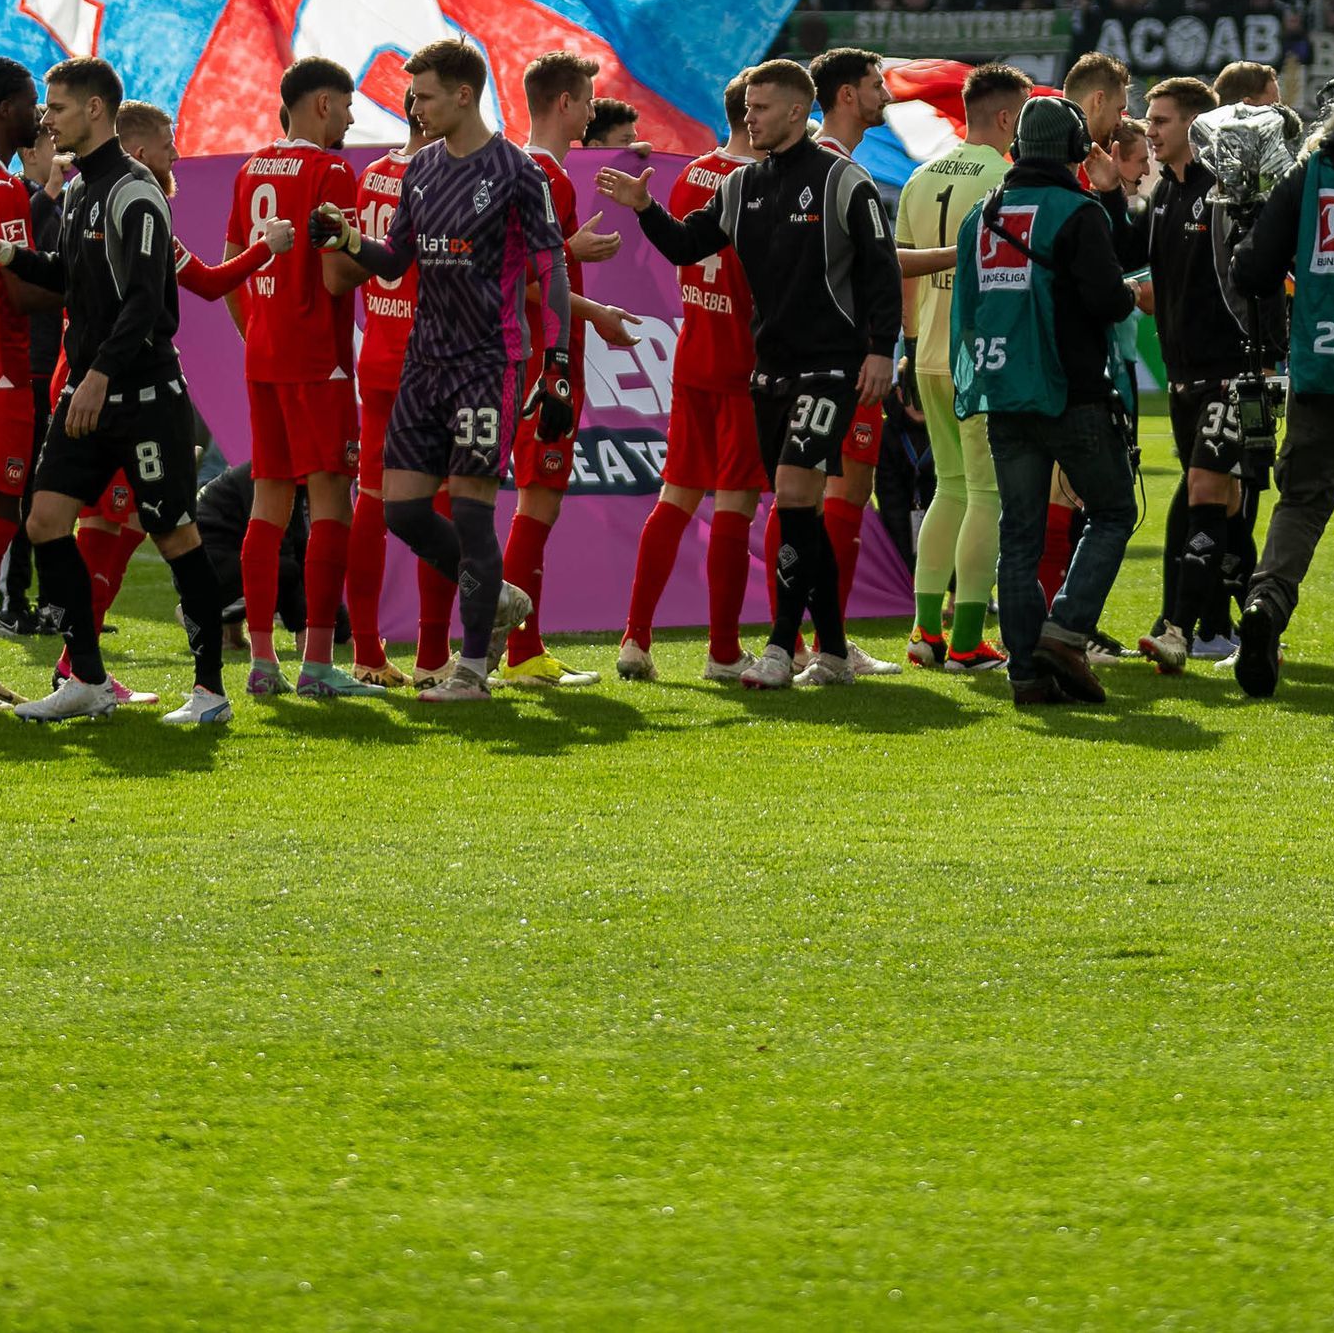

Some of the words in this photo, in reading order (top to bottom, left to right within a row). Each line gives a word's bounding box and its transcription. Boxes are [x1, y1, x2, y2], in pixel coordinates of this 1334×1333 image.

[246, 158, 304, 177] HEIDENHEIM
[249, 182, 277, 271] 8
[789, 213, 819, 223] flatex
[936, 184, 955, 248] 1
[974, 337, 1007, 372] 35
[454, 407, 500, 447] 33
[790, 394, 838, 436] 30
[135, 440, 165, 482] 8
